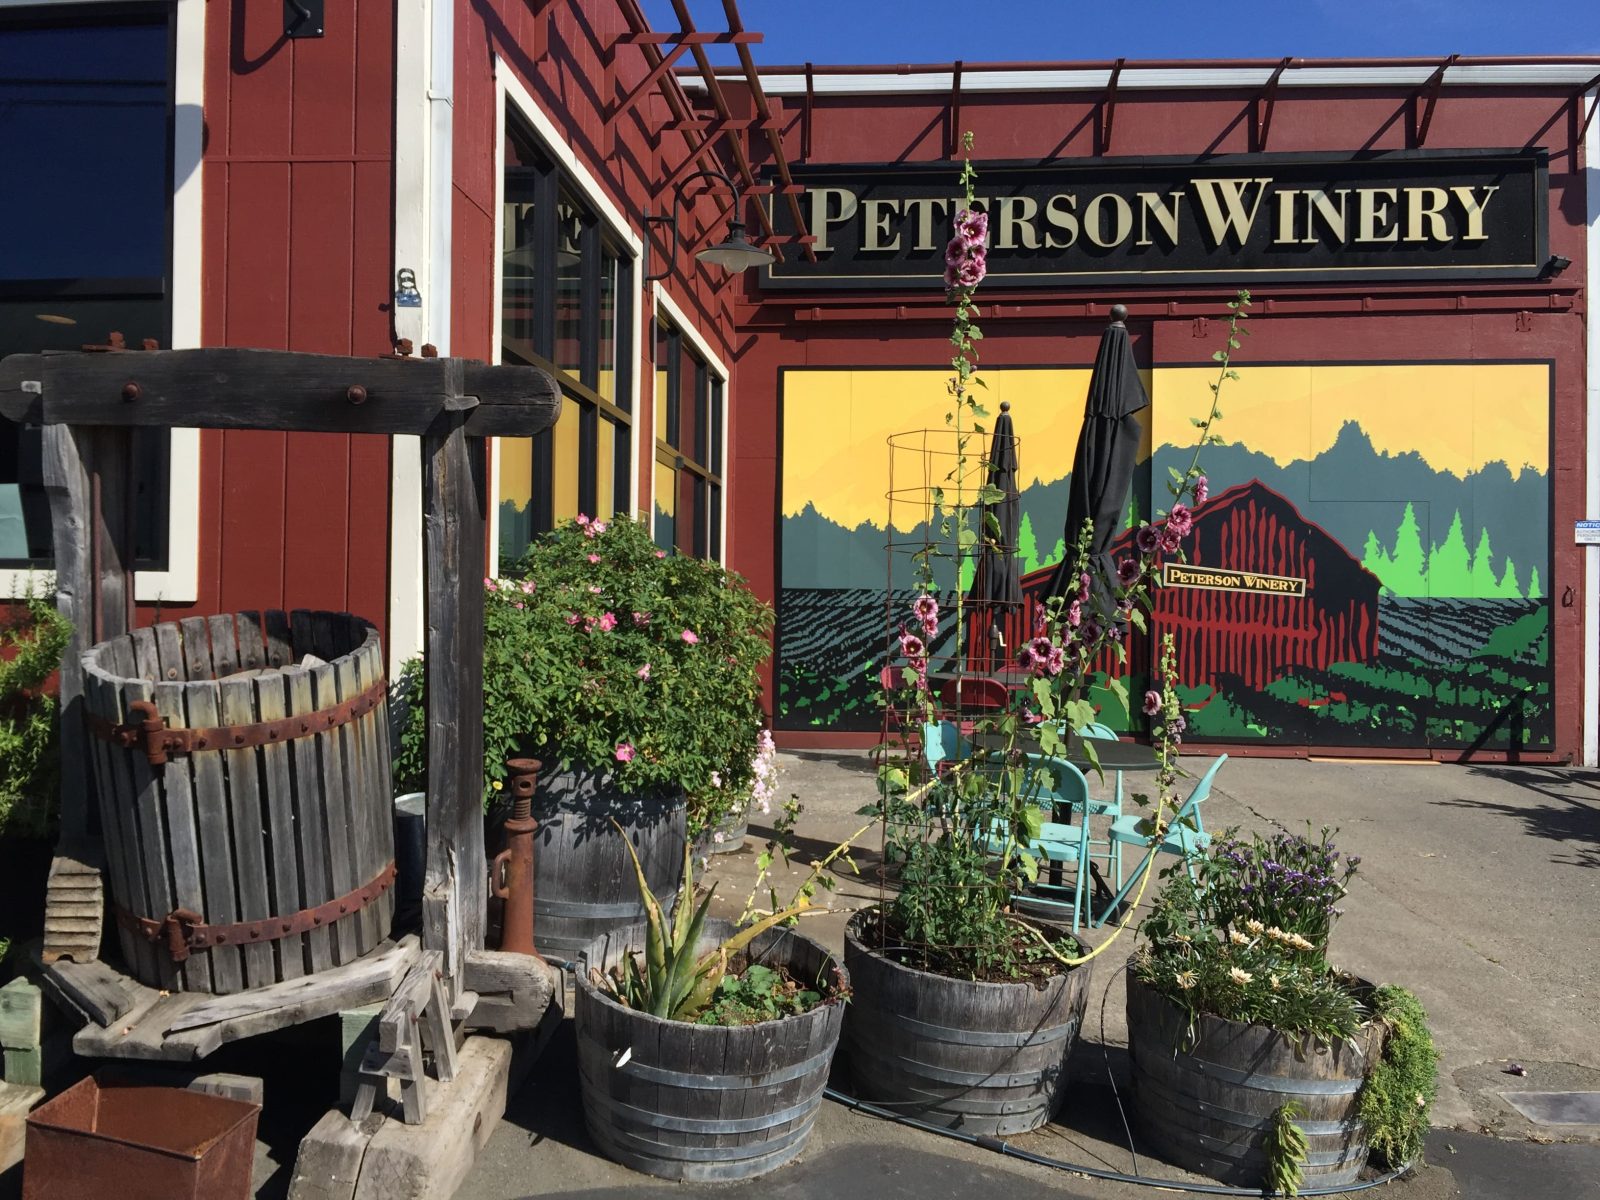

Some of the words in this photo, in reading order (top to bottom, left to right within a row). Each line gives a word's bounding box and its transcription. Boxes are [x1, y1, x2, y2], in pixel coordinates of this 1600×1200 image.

[1190, 177, 1499, 246] WINERY
[1170, 569, 1240, 587] PETERSON
[1243, 575, 1299, 592] WINERY
